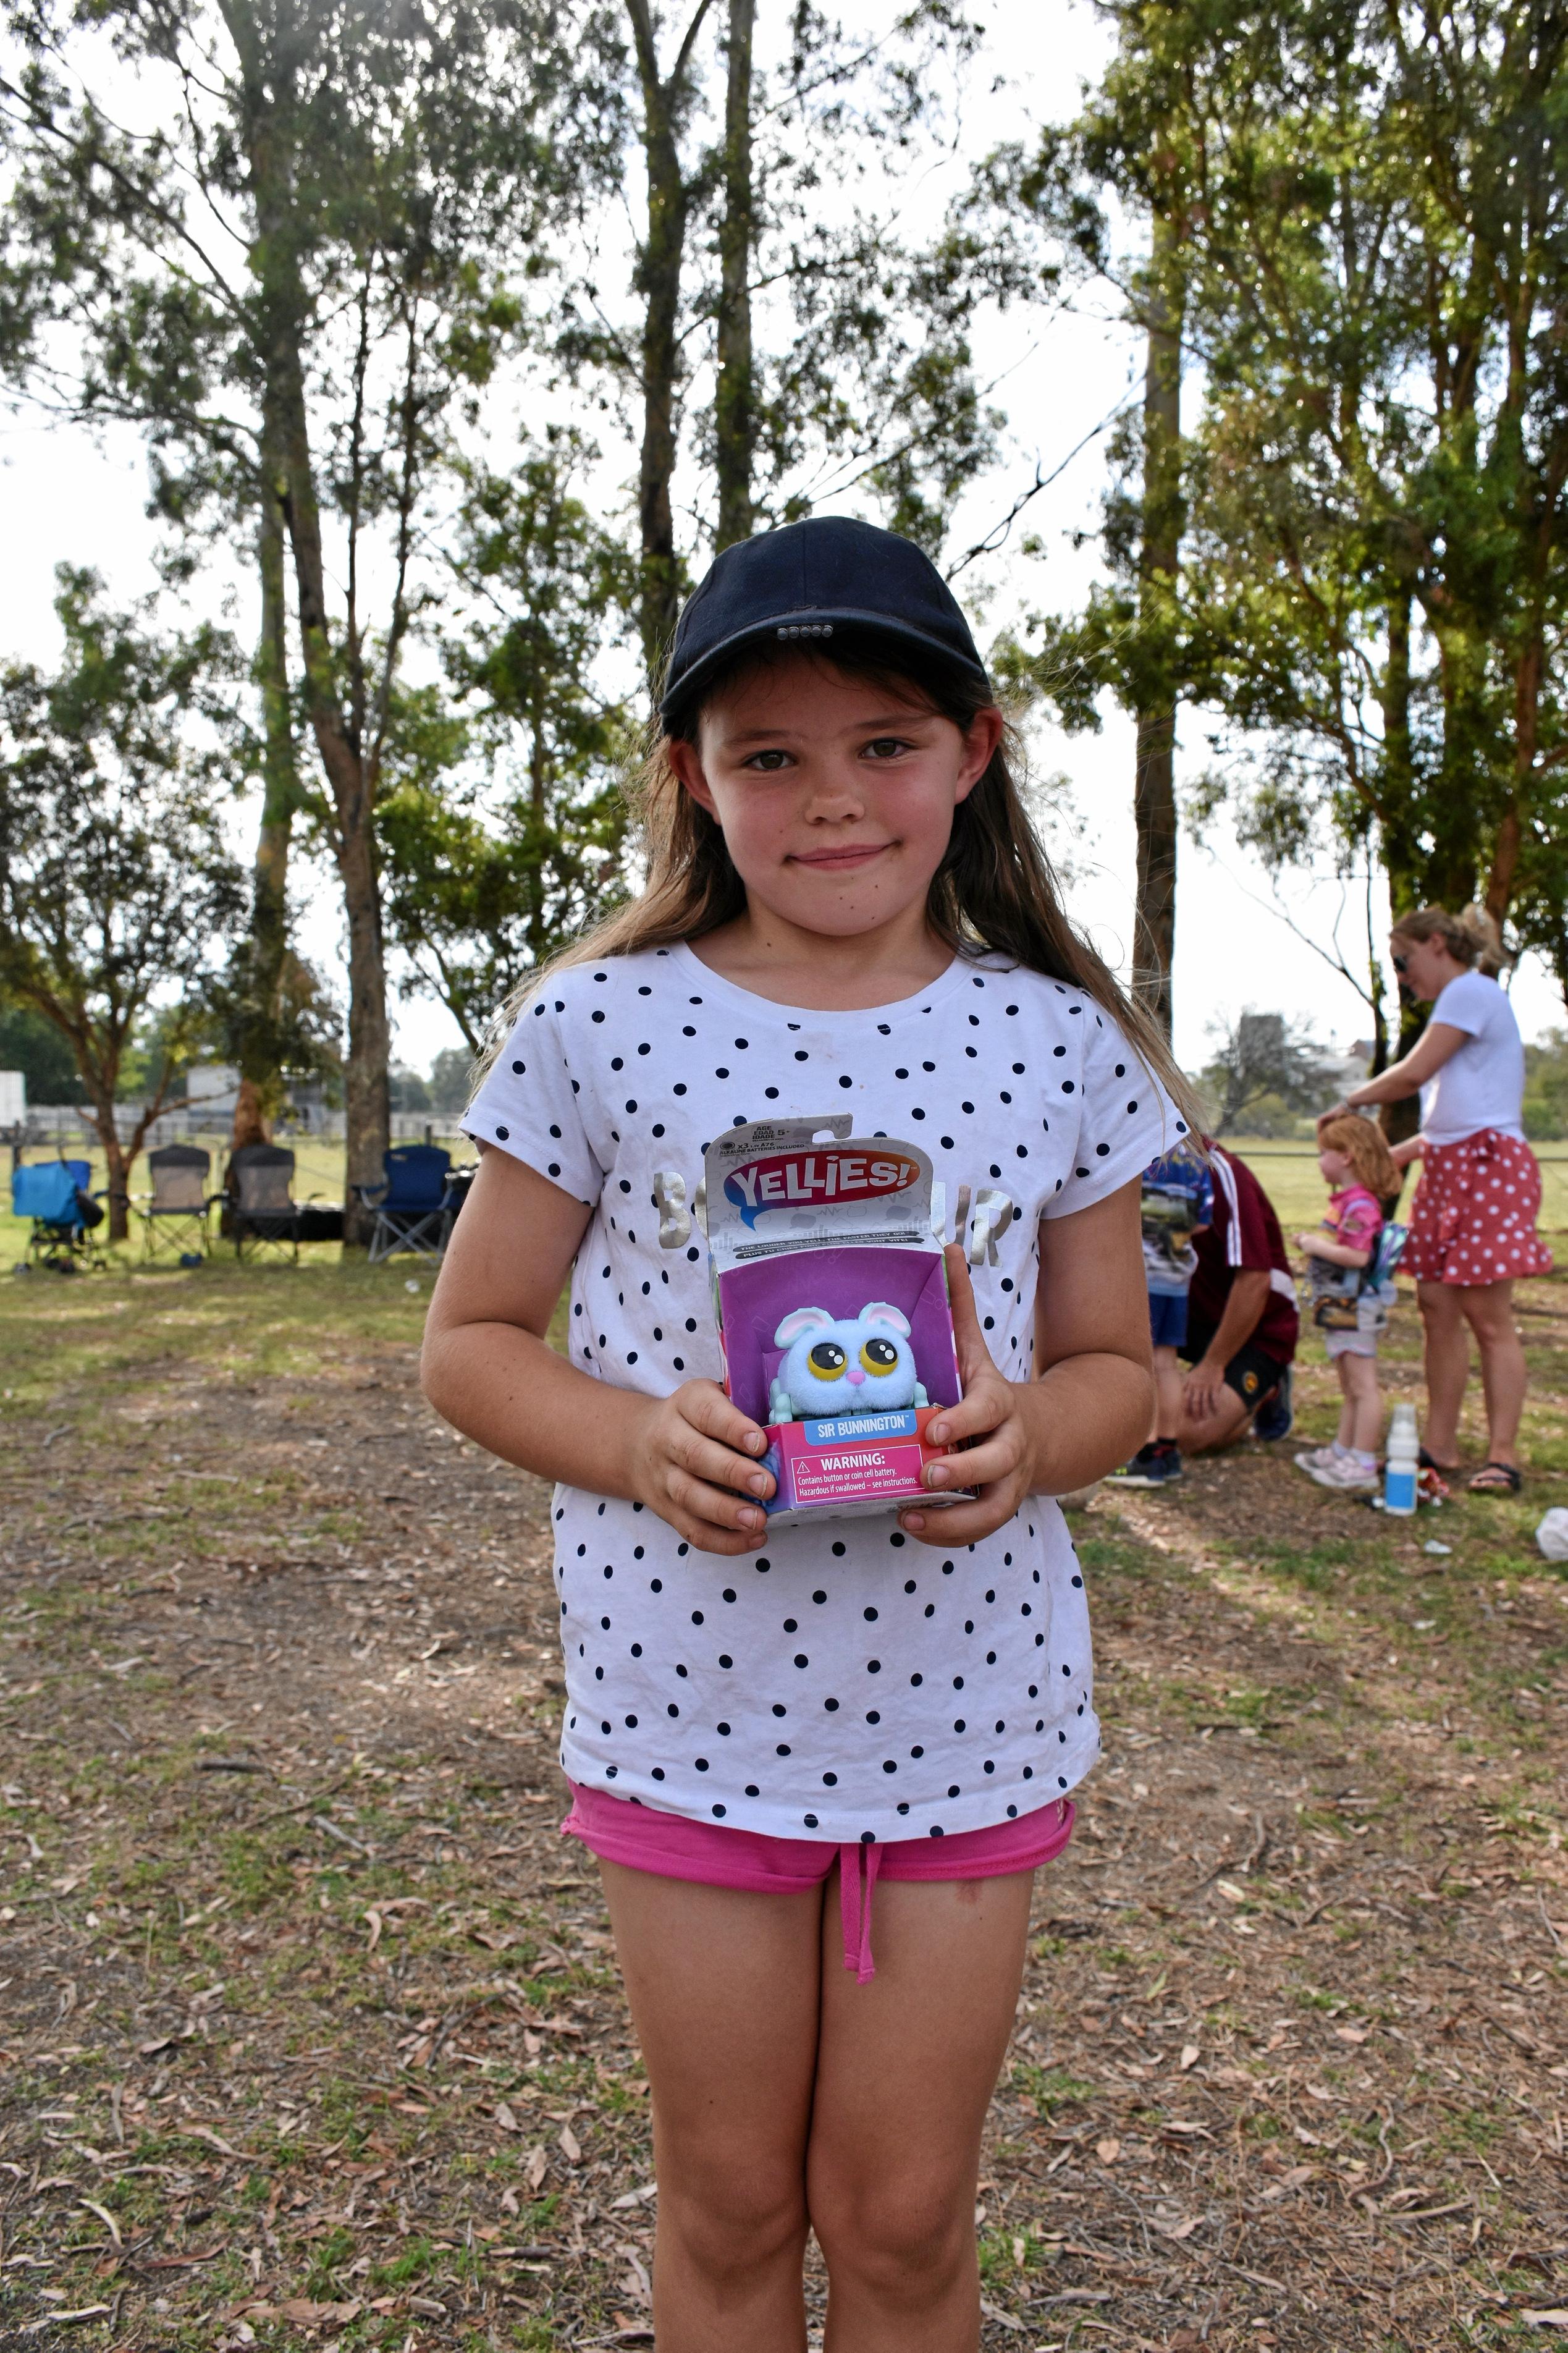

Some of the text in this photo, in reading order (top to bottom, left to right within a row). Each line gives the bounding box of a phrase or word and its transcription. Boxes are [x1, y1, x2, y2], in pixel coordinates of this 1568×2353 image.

[817, 1414, 906, 1438] SIR BUNNINGTON
[820, 1453, 885, 1471] WARNING:
[798, 1476, 823, 1485] Contains
[823, 1474, 843, 1483] button
[851, 1471, 863, 1479] coin
[864, 1469, 874, 1478] cell
[874, 1468, 897, 1477] battery.
[799, 1486, 830, 1497] Hazardous
[830, 1484, 835, 1493] if
[835, 1481, 866, 1493] swallowed
[872, 1481, 882, 1489] see
[883, 1476, 917, 1487] instructions.
